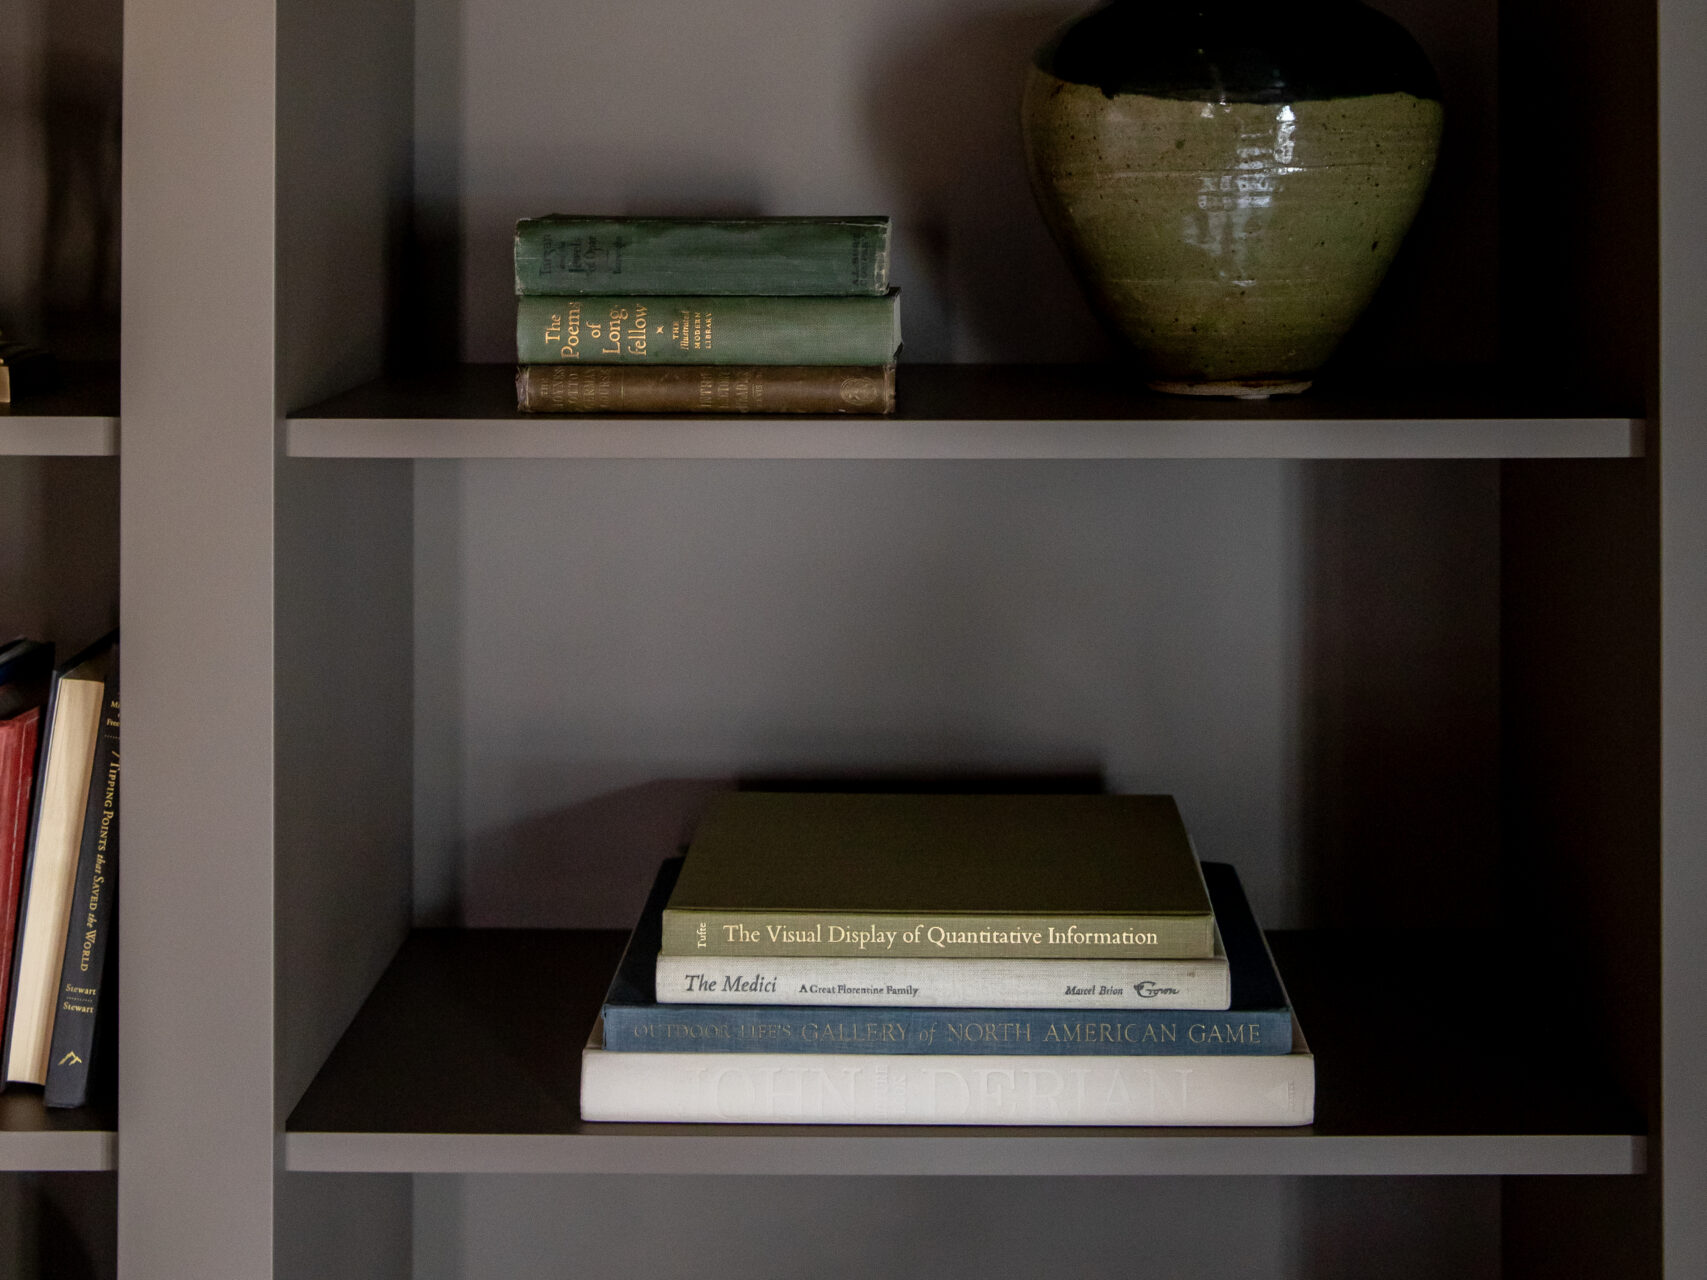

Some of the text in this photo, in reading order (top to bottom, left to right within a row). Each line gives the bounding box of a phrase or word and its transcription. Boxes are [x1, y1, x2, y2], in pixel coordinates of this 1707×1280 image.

[545, 314, 561, 344] The
[561, 302, 581, 359] Poems
[586, 320, 601, 339] of
[628, 304, 648, 357] fellow
[672, 322, 680, 340] THE
[705, 312, 713, 350] LIBRARY
[104, 761, 120, 808] TIPPING
[98, 810, 114, 852] POINTS
[94, 854, 107, 874] that
[89, 875, 105, 911] SAVED
[86, 913, 97, 927] the
[697, 922, 707, 949] Tufte
[723, 924, 1159, 949] The Visual Display of Quantitative Information
[80, 929, 97, 972] WORLD
[65, 983, 97, 996] Stewart
[685, 974, 777, 993] The Medici
[799, 984, 919, 997] A Great Florentine Family
[1064, 985, 1096, 996] Marcel
[1099, 985, 1124, 996] Brion
[62, 1001, 94, 1014] Stewart
[634, 1023, 731, 1040] OUTDOOR
[801, 1023, 909, 1042] GALLERY
[919, 1022, 938, 1045] of
[947, 1023, 1031, 1042] NORTH
[1043, 1023, 1177, 1043] AMERICAN
[1188, 1023, 1261, 1044] GAME
[919, 1067, 1194, 1118] DERIAN
